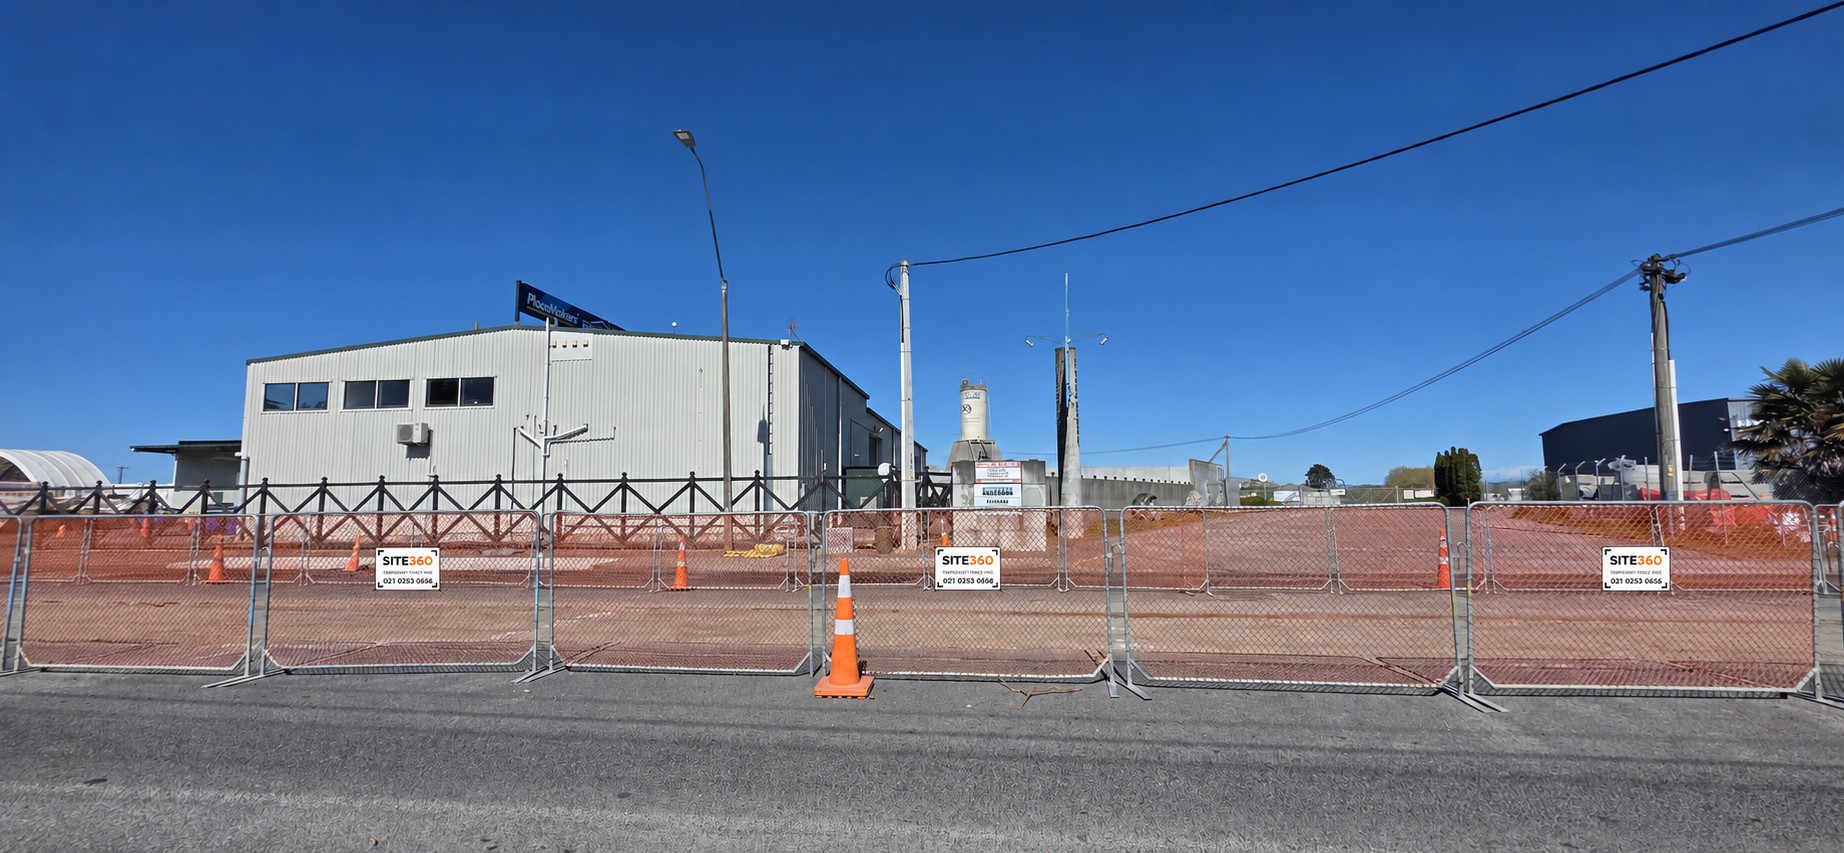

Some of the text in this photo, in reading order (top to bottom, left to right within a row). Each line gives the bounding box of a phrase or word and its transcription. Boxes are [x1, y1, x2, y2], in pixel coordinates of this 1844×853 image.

[383, 556, 433, 566] SITE360
[942, 555, 994, 565] SITE360
[1610, 555, 1663, 565] SITE360
